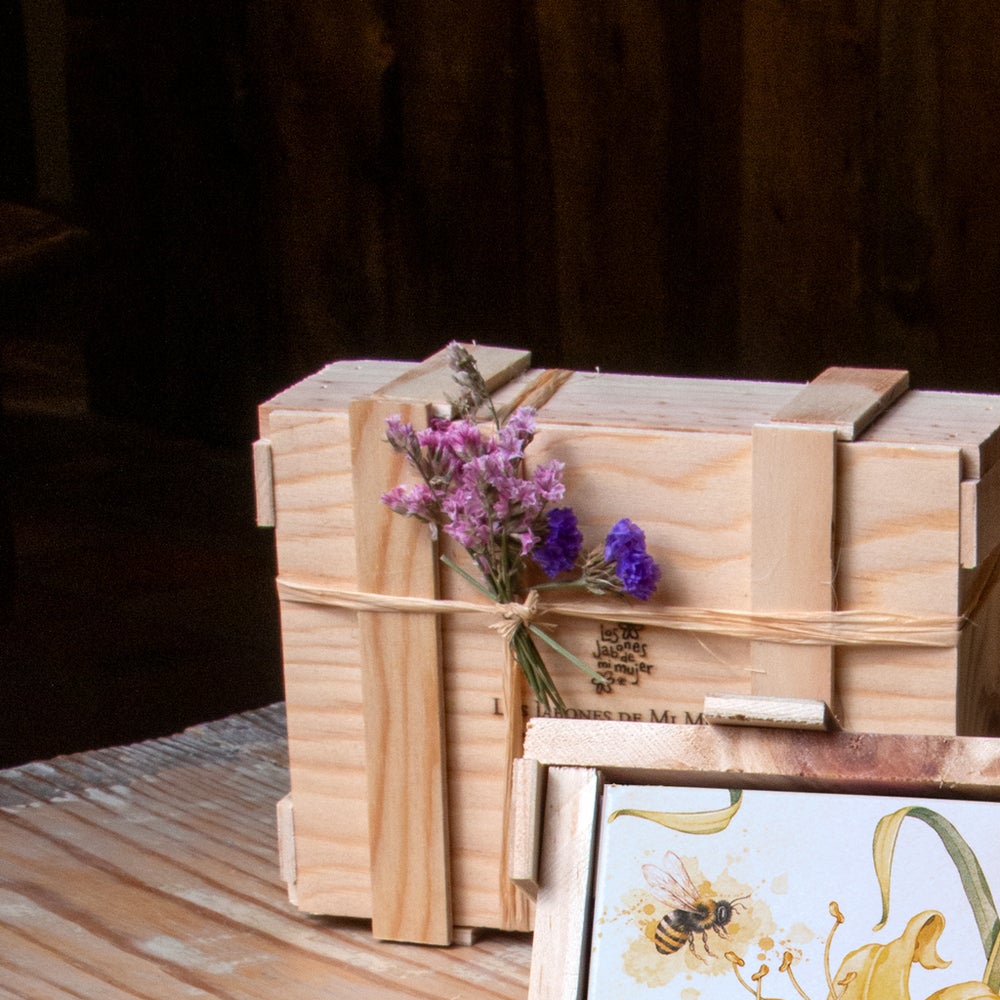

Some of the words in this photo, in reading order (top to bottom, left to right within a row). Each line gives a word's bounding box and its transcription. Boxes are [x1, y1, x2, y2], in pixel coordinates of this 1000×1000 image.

[600, 624, 618, 643] Los
[592, 640, 647, 659] Jabones
[620, 652, 635, 663] de
[597, 660, 611, 668] mi
[614, 661, 654, 685] mujer
[492, 698, 529, 717] LS
